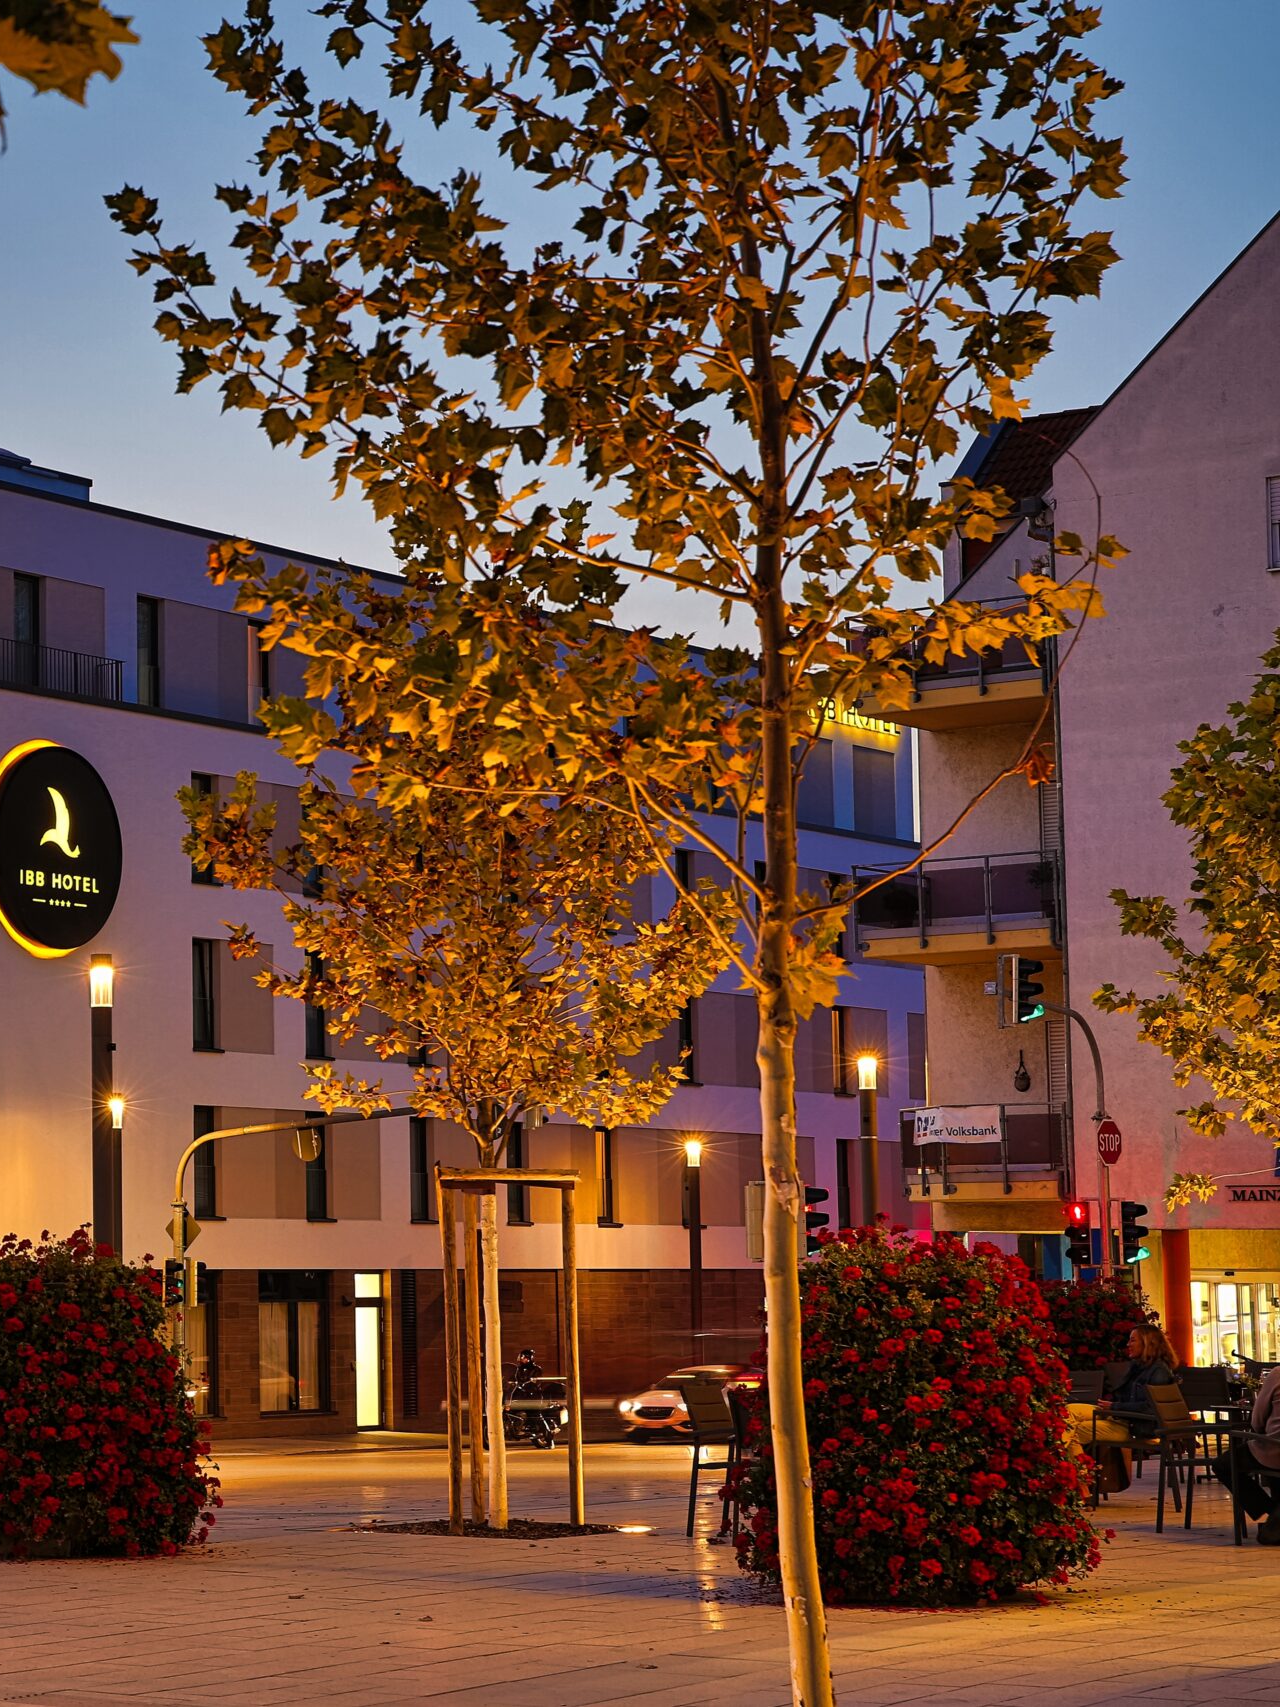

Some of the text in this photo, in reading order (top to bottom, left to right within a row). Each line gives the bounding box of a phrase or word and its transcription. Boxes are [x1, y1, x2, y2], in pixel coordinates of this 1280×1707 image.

[20, 869, 99, 893] IBB HOTEL
[945, 1125, 998, 1137] Volksbank
[1099, 1134, 1120, 1152] STOP
